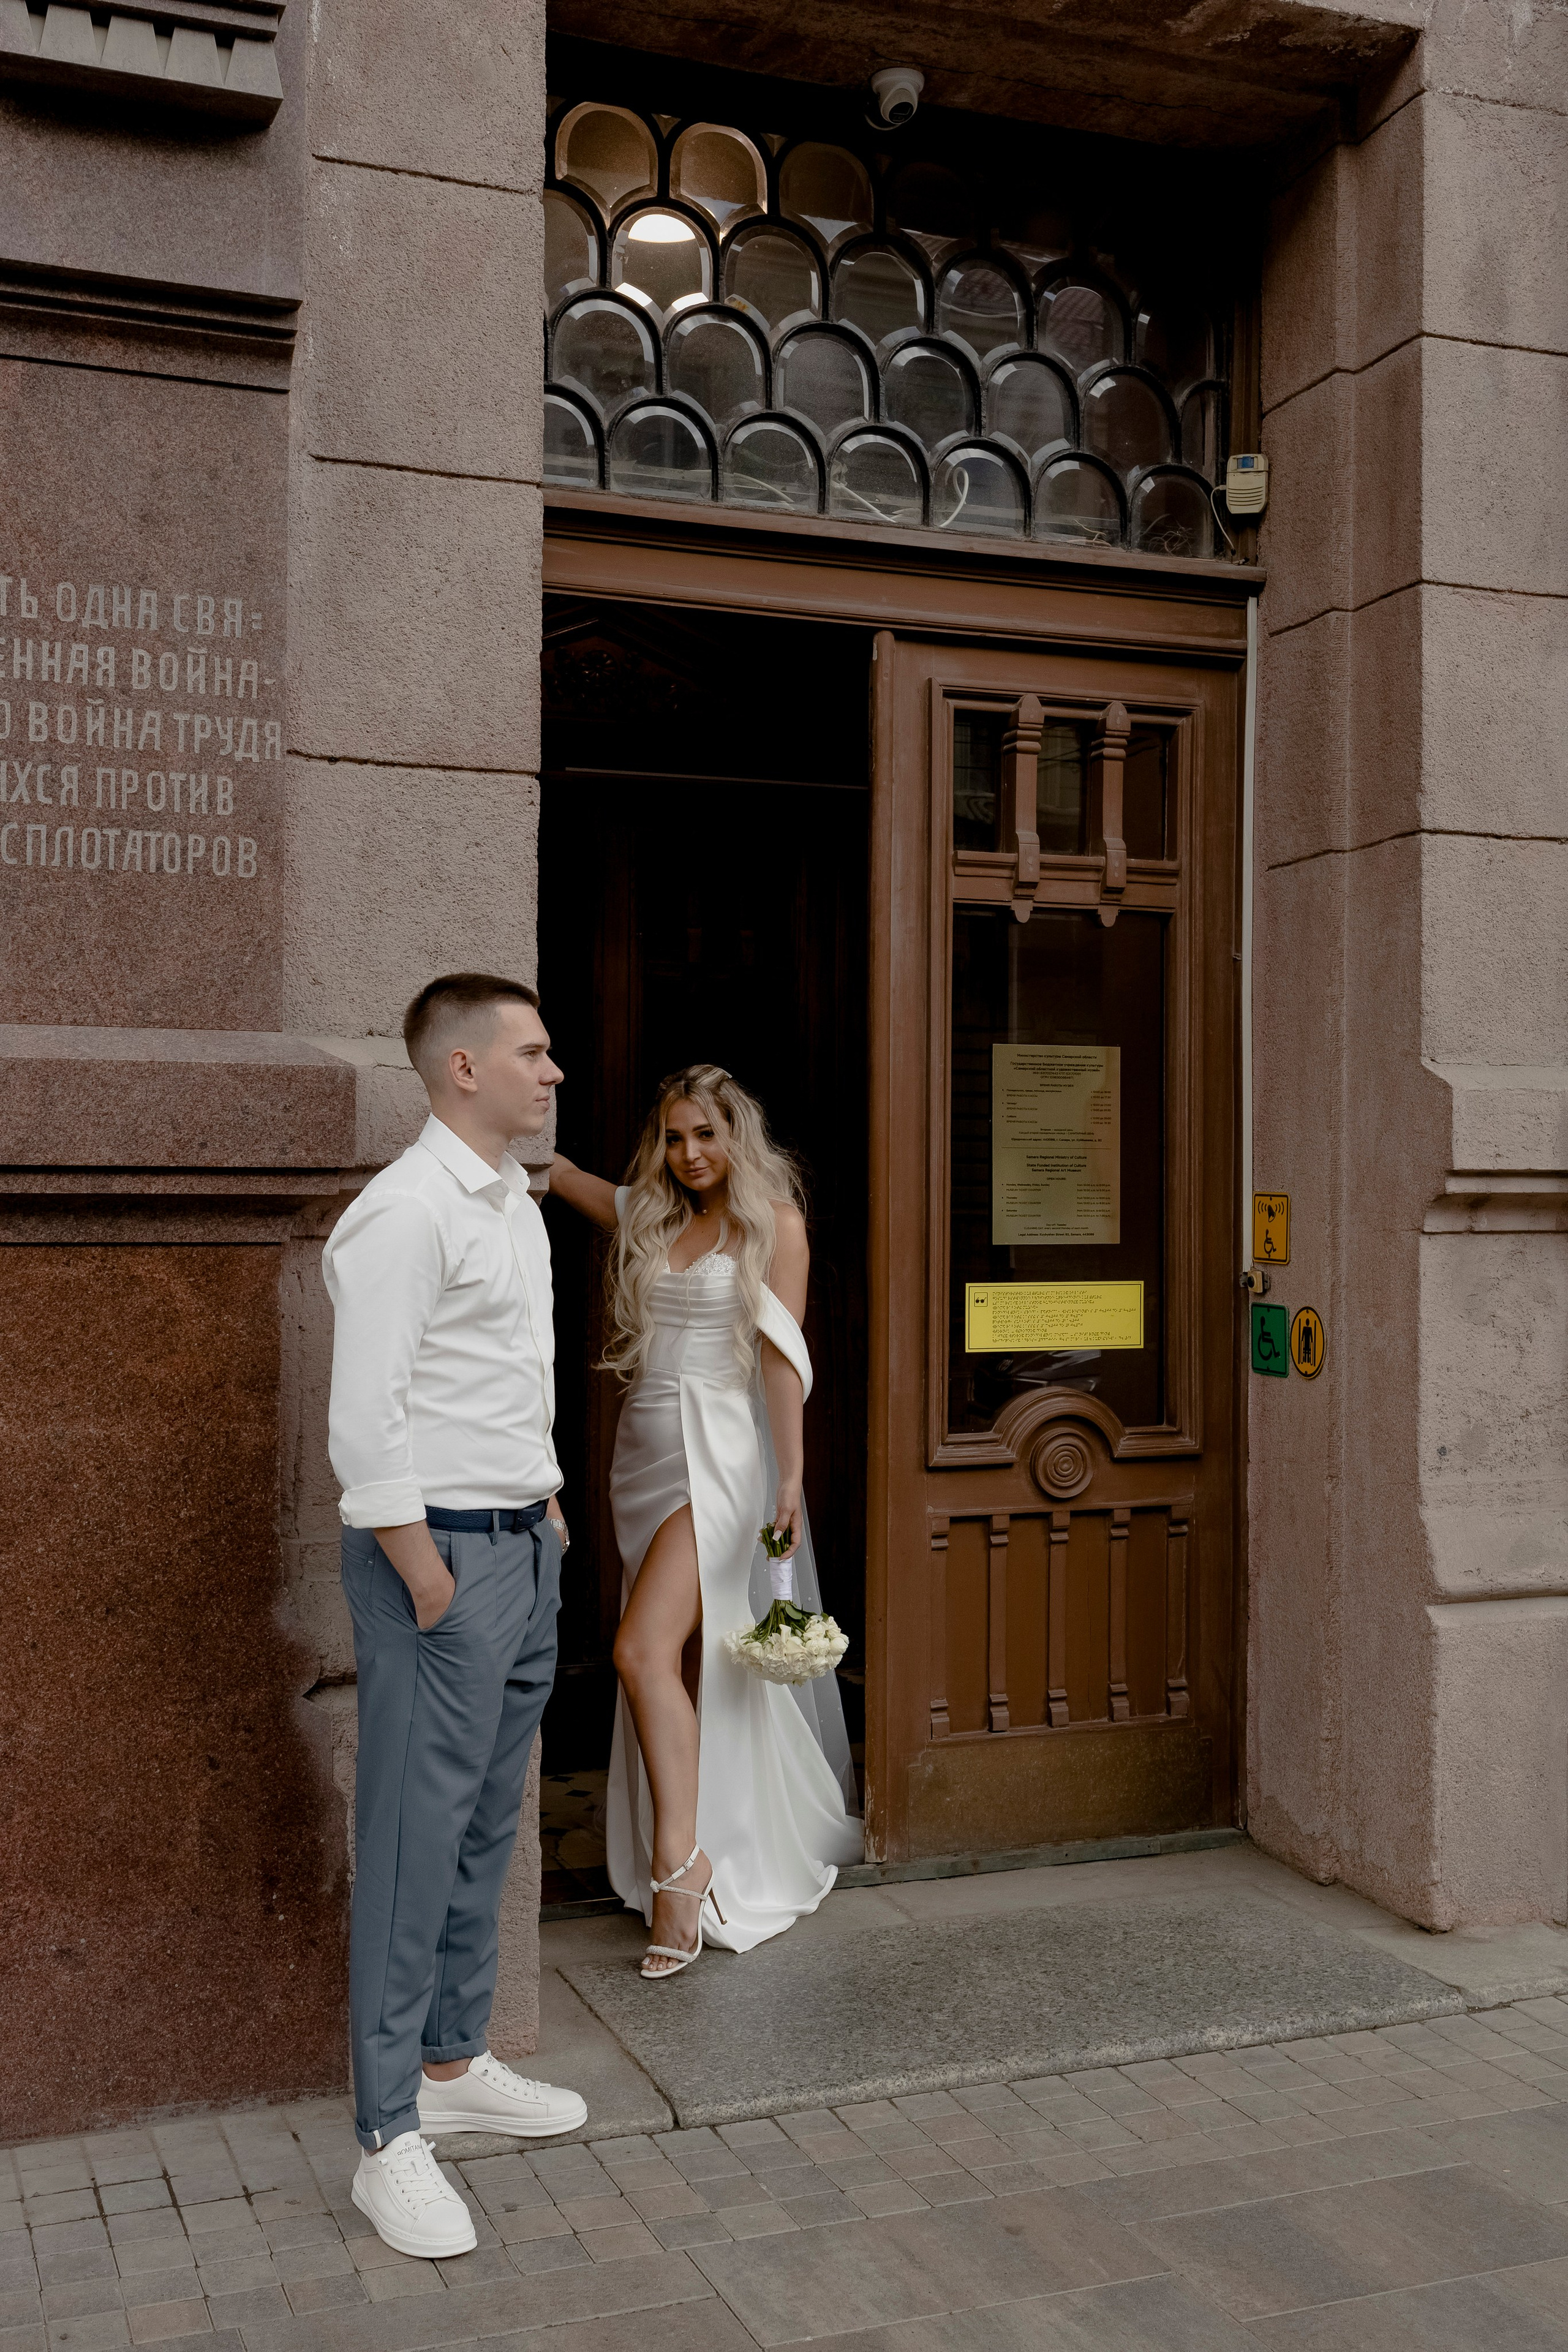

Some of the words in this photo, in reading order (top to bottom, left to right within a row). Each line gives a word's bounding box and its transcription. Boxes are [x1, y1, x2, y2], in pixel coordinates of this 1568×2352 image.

[56, 582, 159, 630] ОДНА
[29, 698, 162, 751] ВОЙНА
[173, 712, 282, 763] ТРУДЯ
[96, 767, 235, 815] ПРОТИВ
[1, 822, 258, 878] СПЛОТАТОРОВ
